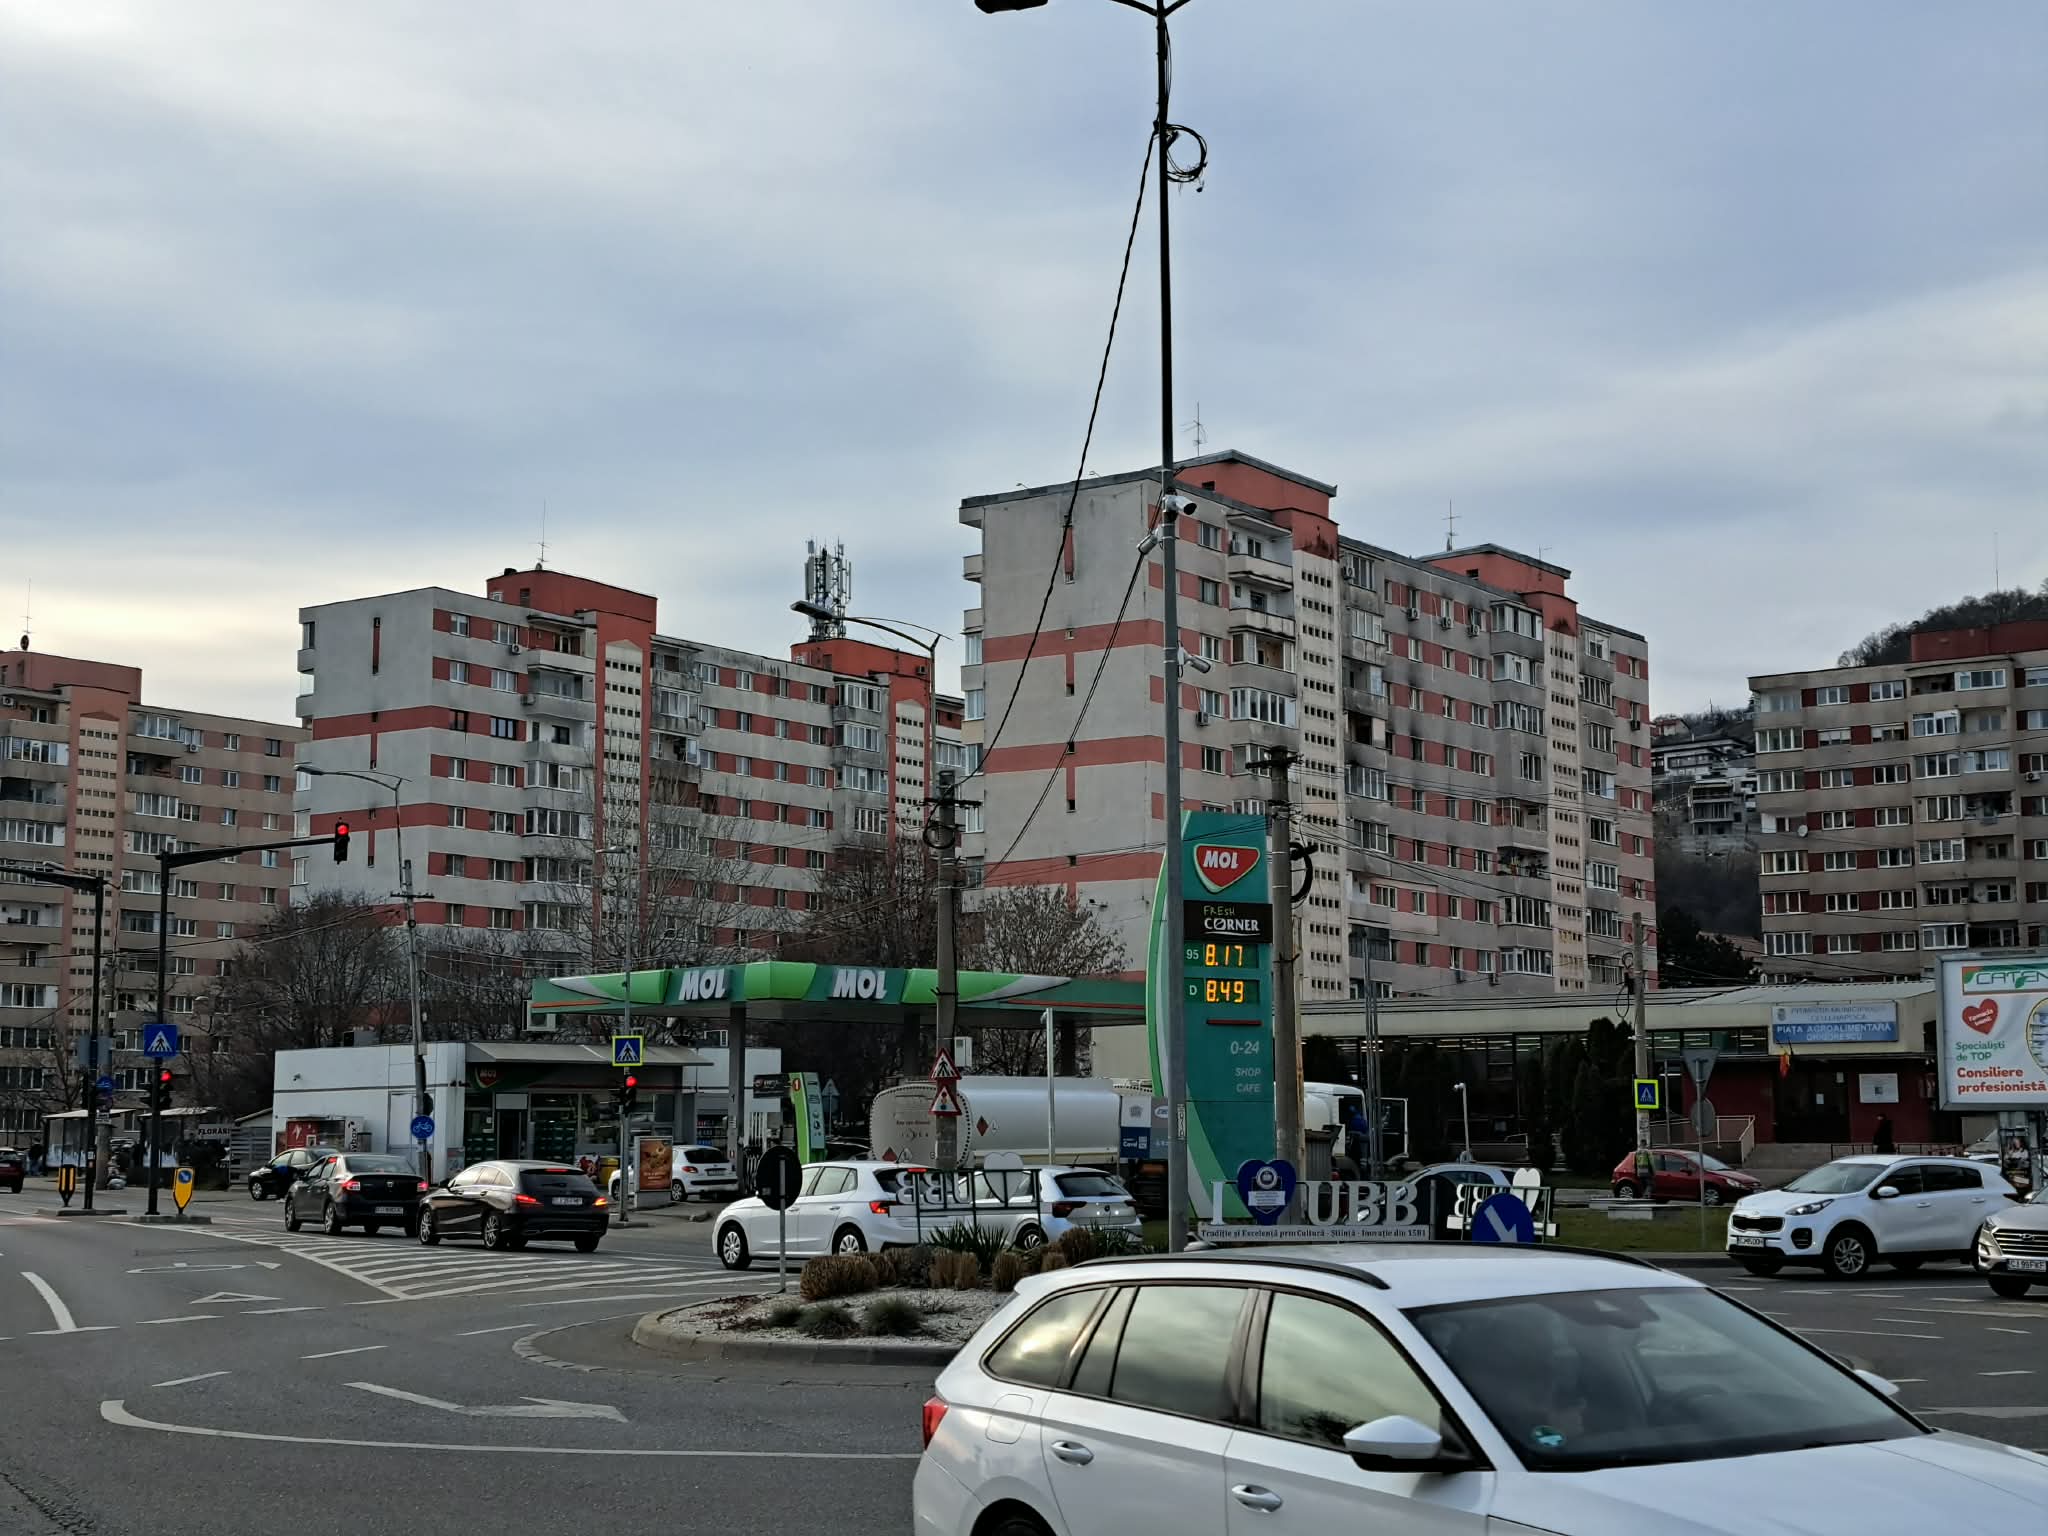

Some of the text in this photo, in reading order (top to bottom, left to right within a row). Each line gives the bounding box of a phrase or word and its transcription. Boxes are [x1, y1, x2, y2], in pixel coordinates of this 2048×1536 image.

[1203, 850, 1239, 869] MOL
[1204, 918, 1260, 931] CORNER
[1186, 943, 1243, 967] 95 8.17
[678, 968, 726, 1000] MOL
[832, 969, 888, 999] MOL
[1189, 980, 1244, 1003] D 8.49
[1230, 1040, 1260, 1054] 0-24
[1956, 1052, 1992, 1061] de TOP
[1235, 1067, 1261, 1077] SHOP
[1956, 1066, 2023, 1078] Consiliere
[1236, 1083, 1261, 1093] CAFE
[1957, 1081, 2047, 1096] profesionistă
[1210, 1180, 1418, 1226] I UBB
